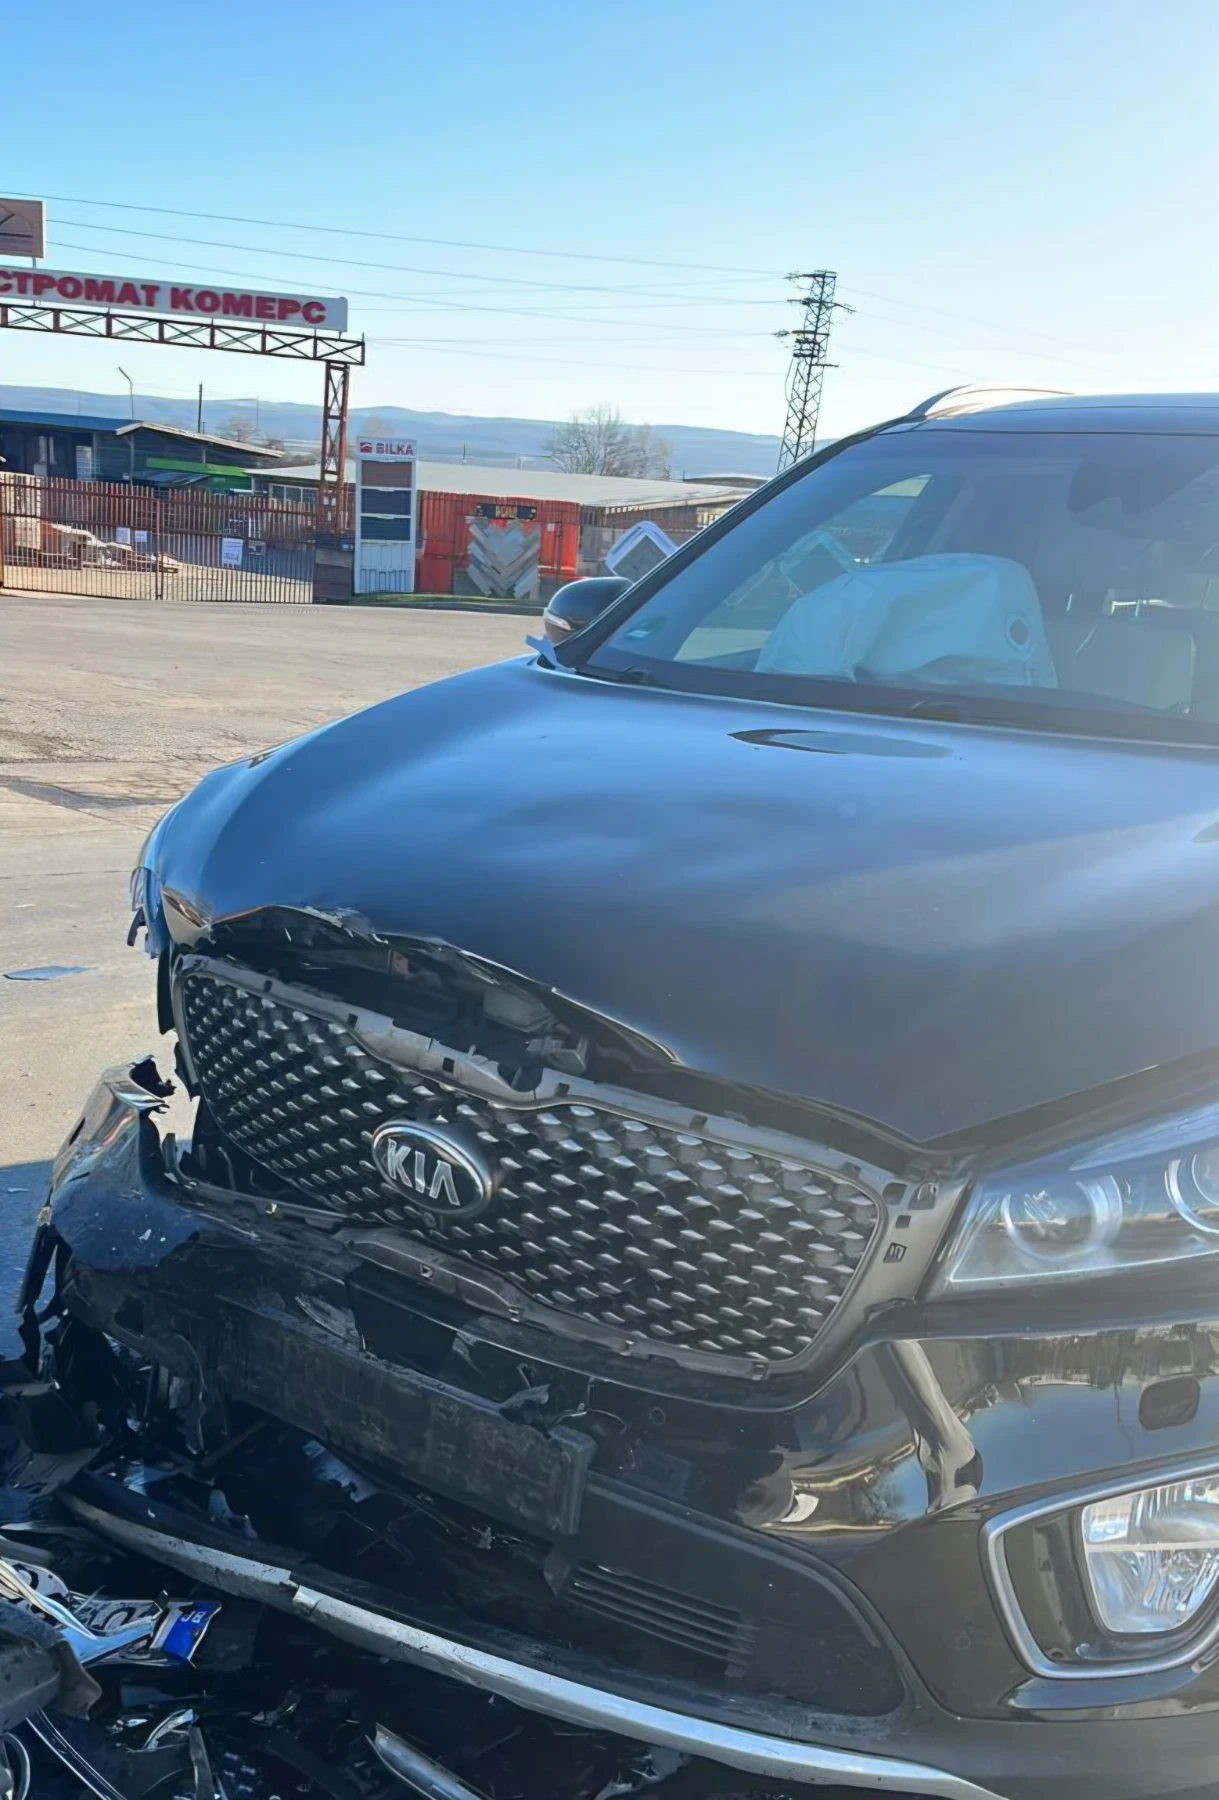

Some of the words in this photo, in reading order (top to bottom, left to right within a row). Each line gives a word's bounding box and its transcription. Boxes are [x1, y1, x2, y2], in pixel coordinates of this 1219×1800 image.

[170, 287, 326, 325] КОМЕРС
[376, 442, 414, 456] BILKA
[387, 1138, 461, 1206] KIA
